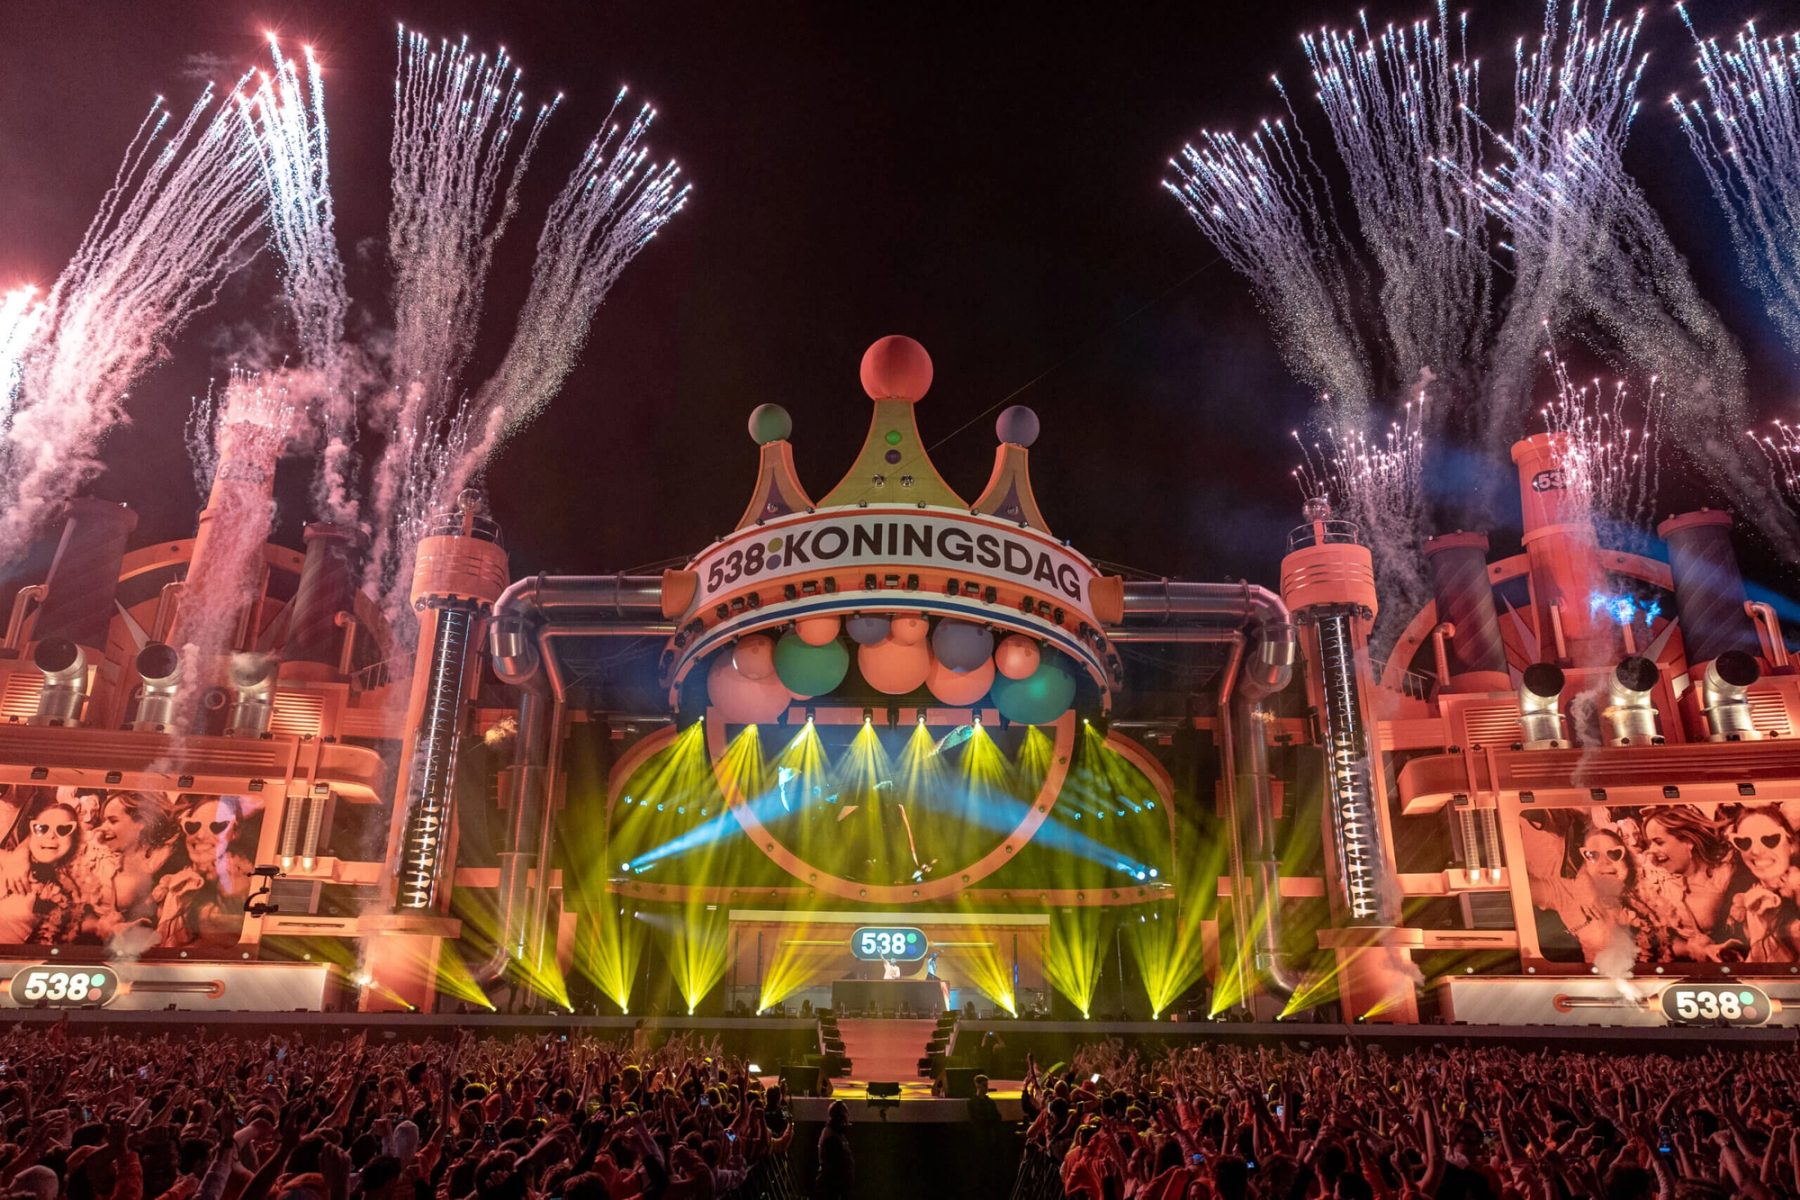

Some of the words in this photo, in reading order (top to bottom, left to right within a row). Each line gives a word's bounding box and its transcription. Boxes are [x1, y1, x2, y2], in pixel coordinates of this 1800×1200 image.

[1538, 472, 1564, 489] 53
[783, 522, 1082, 602] KONINGSDAG
[861, 932, 906, 955] 538
[24, 972, 90, 1000] 538
[1675, 991, 1742, 1020] 538
